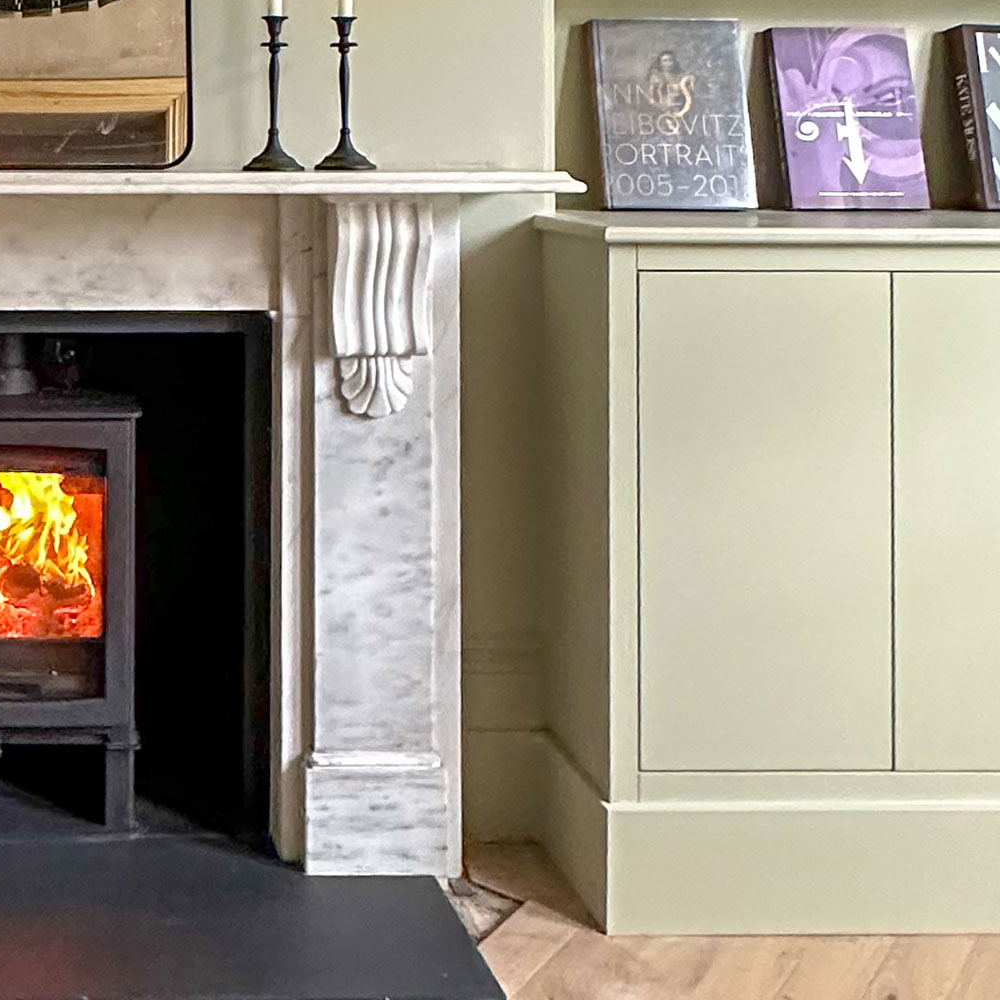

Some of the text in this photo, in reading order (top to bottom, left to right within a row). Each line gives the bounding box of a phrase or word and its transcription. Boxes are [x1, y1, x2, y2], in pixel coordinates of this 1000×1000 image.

[604, 82, 682, 106] NNIE
[612, 112, 744, 136] EIBOVITZ
[608, 173, 748, 197] 005-201
